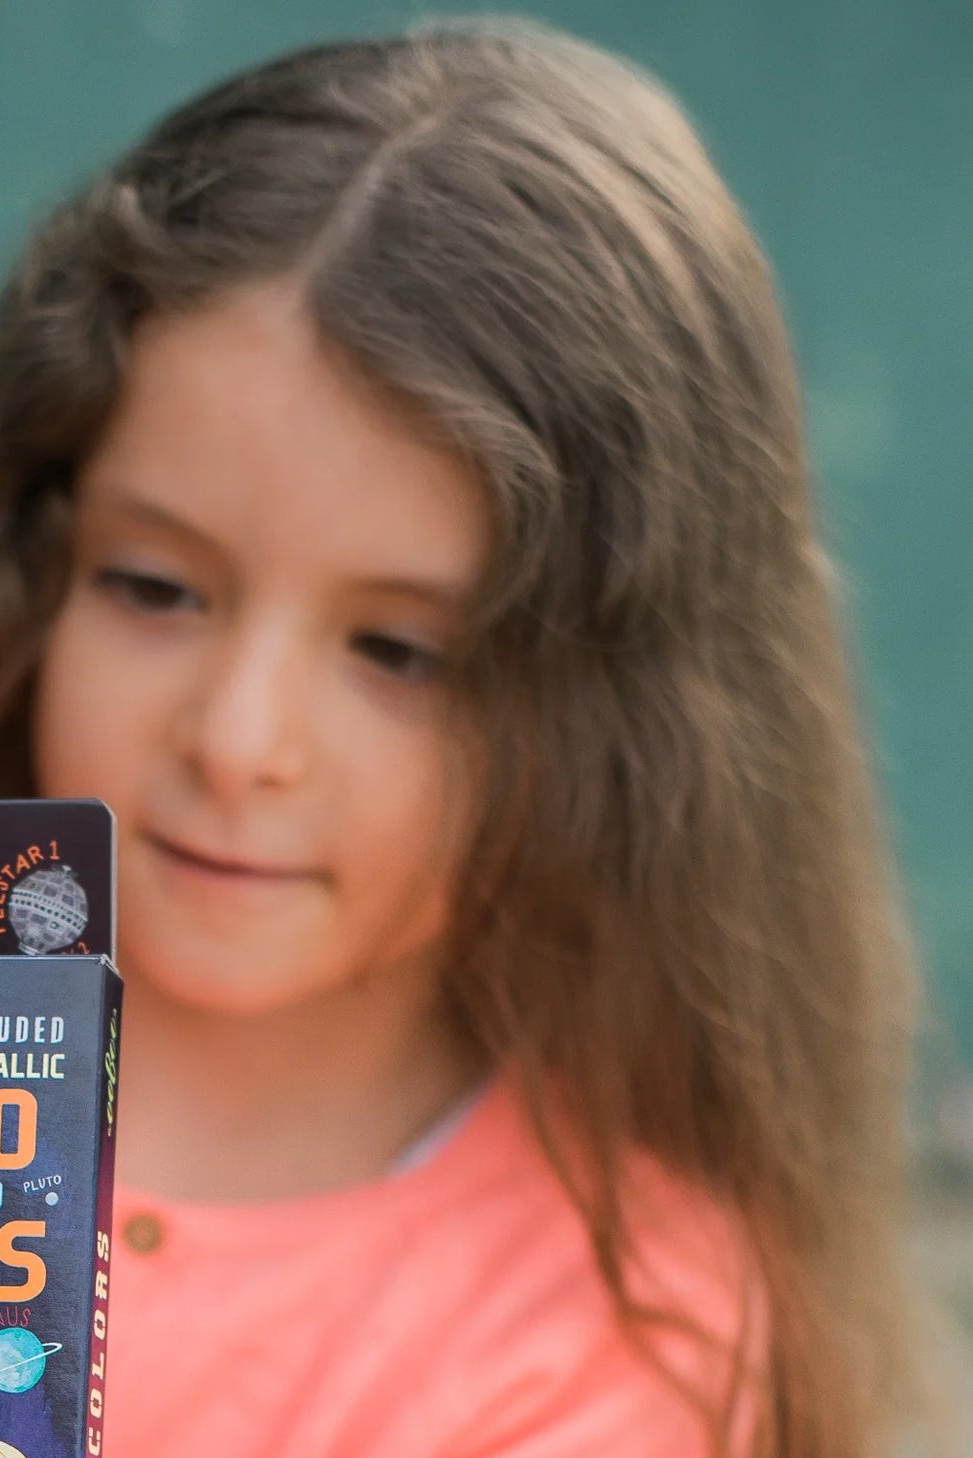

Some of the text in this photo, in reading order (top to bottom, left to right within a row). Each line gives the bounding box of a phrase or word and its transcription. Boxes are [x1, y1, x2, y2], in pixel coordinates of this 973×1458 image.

[49, 840, 60, 860] 1
[23, 1175, 63, 1193] PLUTO
[87, 1231, 109, 1456] COLORS
